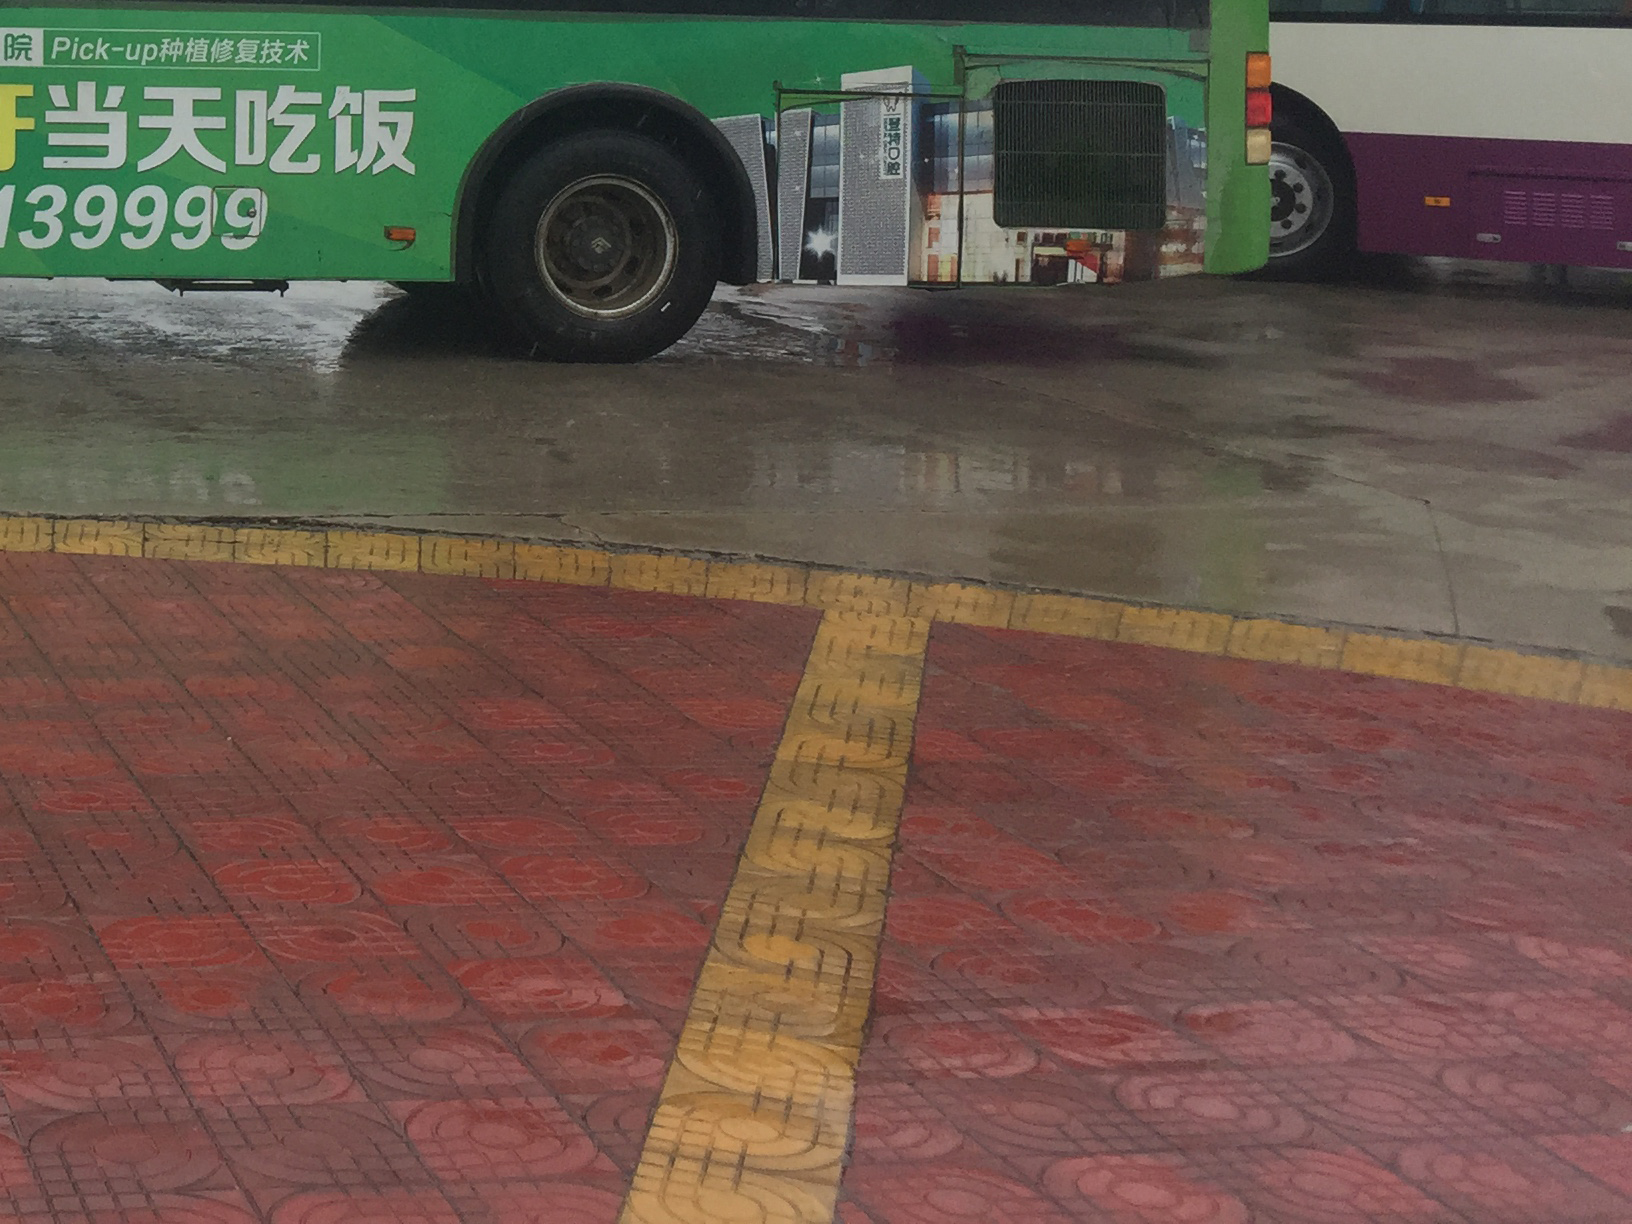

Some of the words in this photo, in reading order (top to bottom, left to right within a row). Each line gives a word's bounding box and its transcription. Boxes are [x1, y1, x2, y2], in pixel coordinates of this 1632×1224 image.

[51, 38, 310, 64] Pick-up种植修复技术
